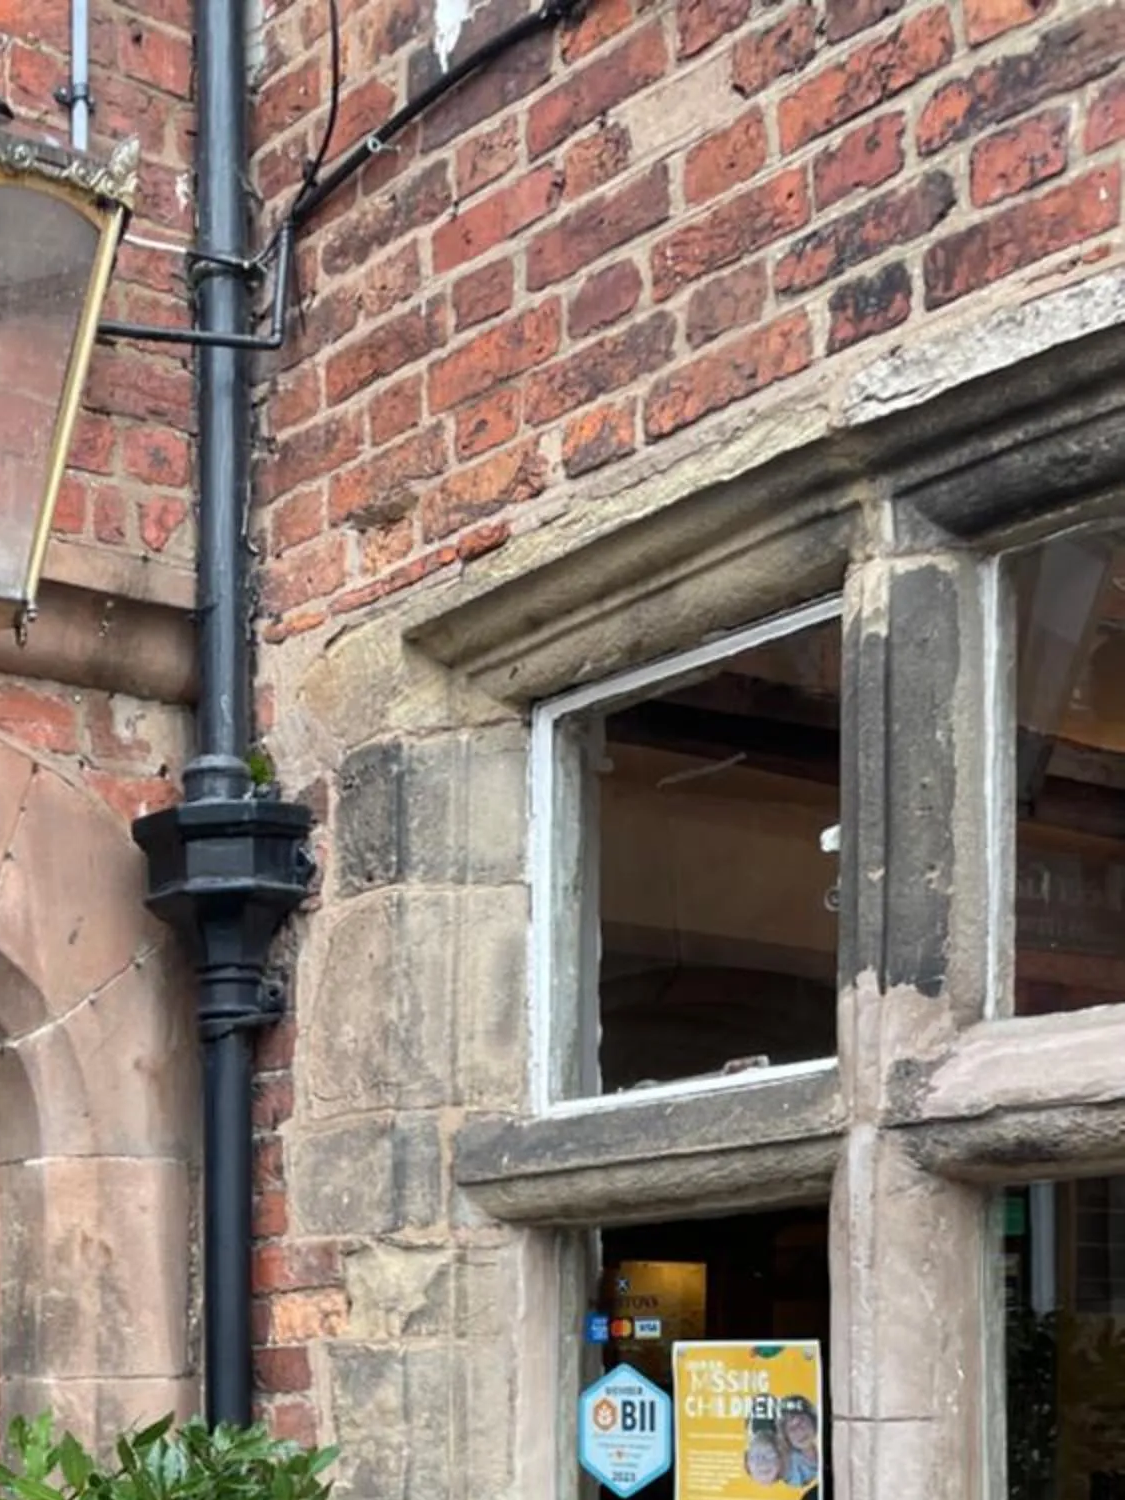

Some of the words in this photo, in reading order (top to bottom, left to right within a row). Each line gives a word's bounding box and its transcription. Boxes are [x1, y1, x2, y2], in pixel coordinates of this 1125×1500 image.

[690, 1369, 770, 1393] MISSING
[621, 1400, 656, 1432] BII
[685, 1394, 783, 1420] CHILDREN
